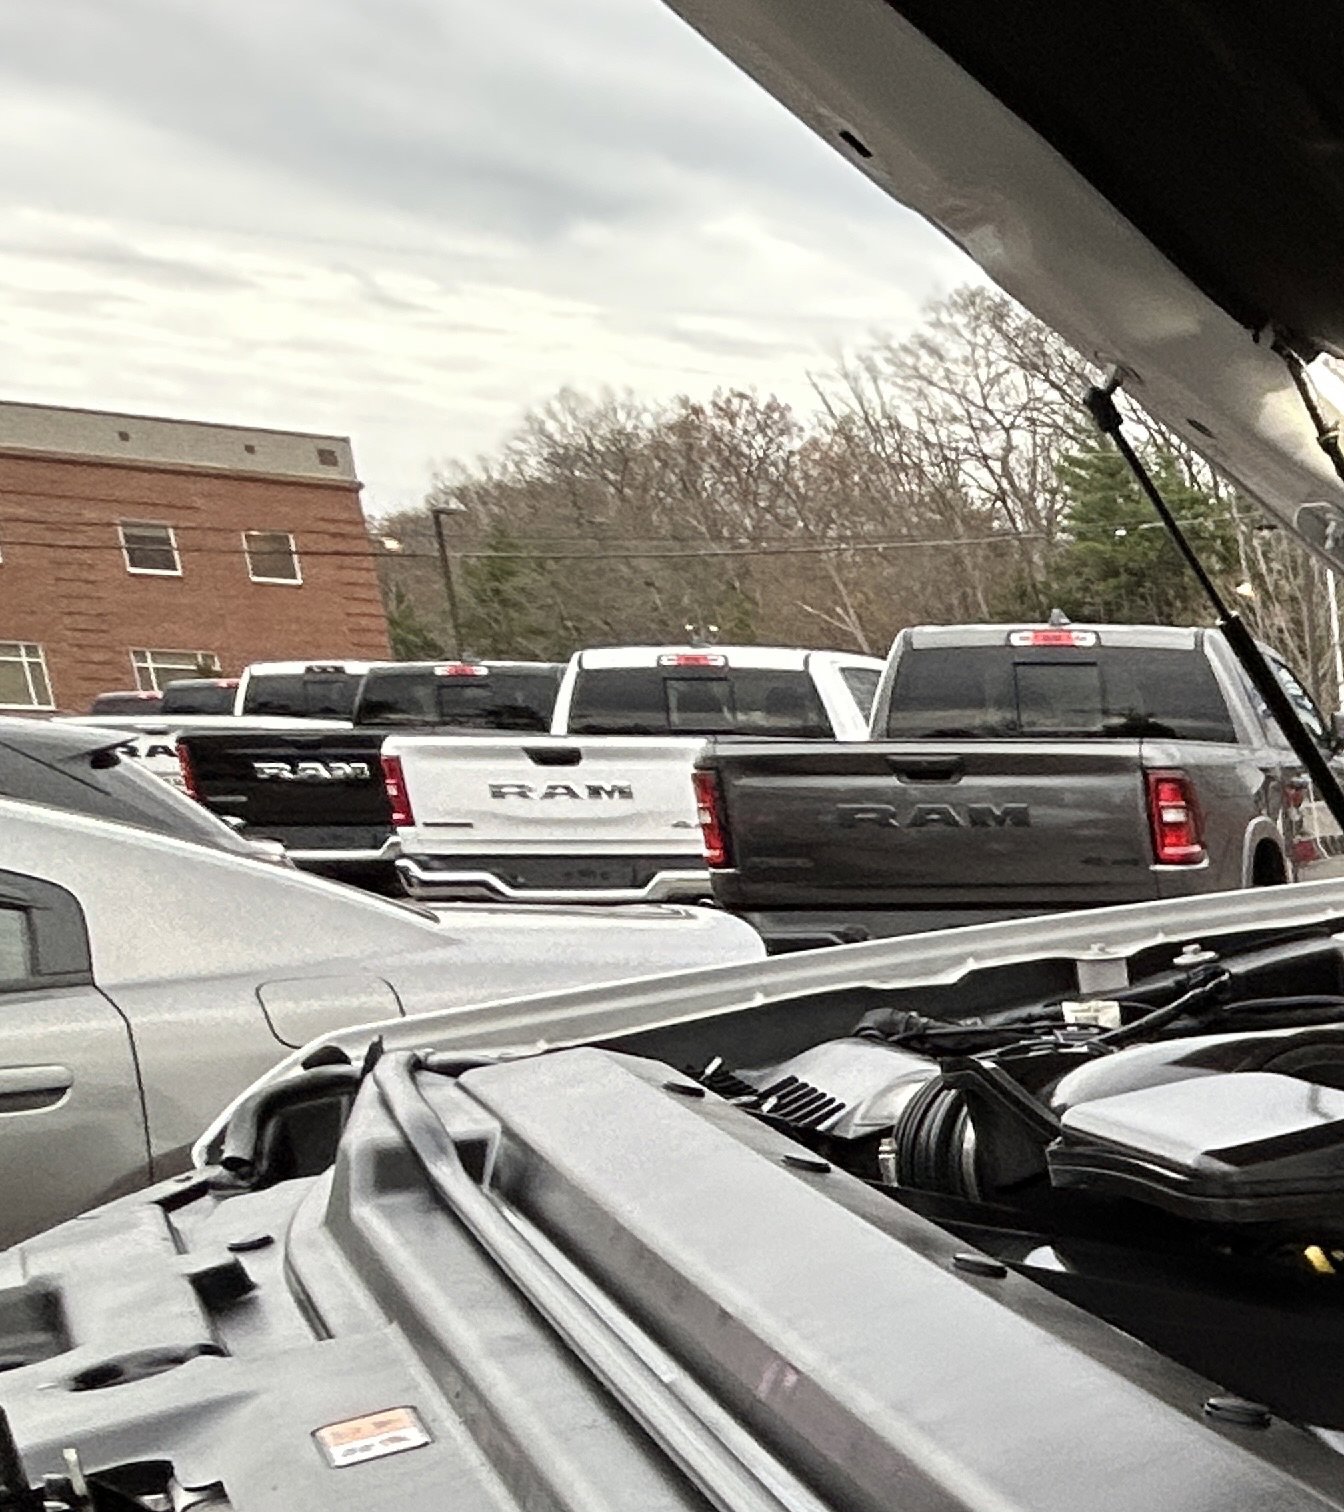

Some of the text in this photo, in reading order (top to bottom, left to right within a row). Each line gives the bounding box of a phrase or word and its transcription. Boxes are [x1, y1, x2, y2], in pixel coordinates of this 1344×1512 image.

[114, 744, 178, 758] RA
[252, 762, 371, 780] RAM
[488, 783, 633, 800] RAM
[836, 803, 1031, 828] RAM
